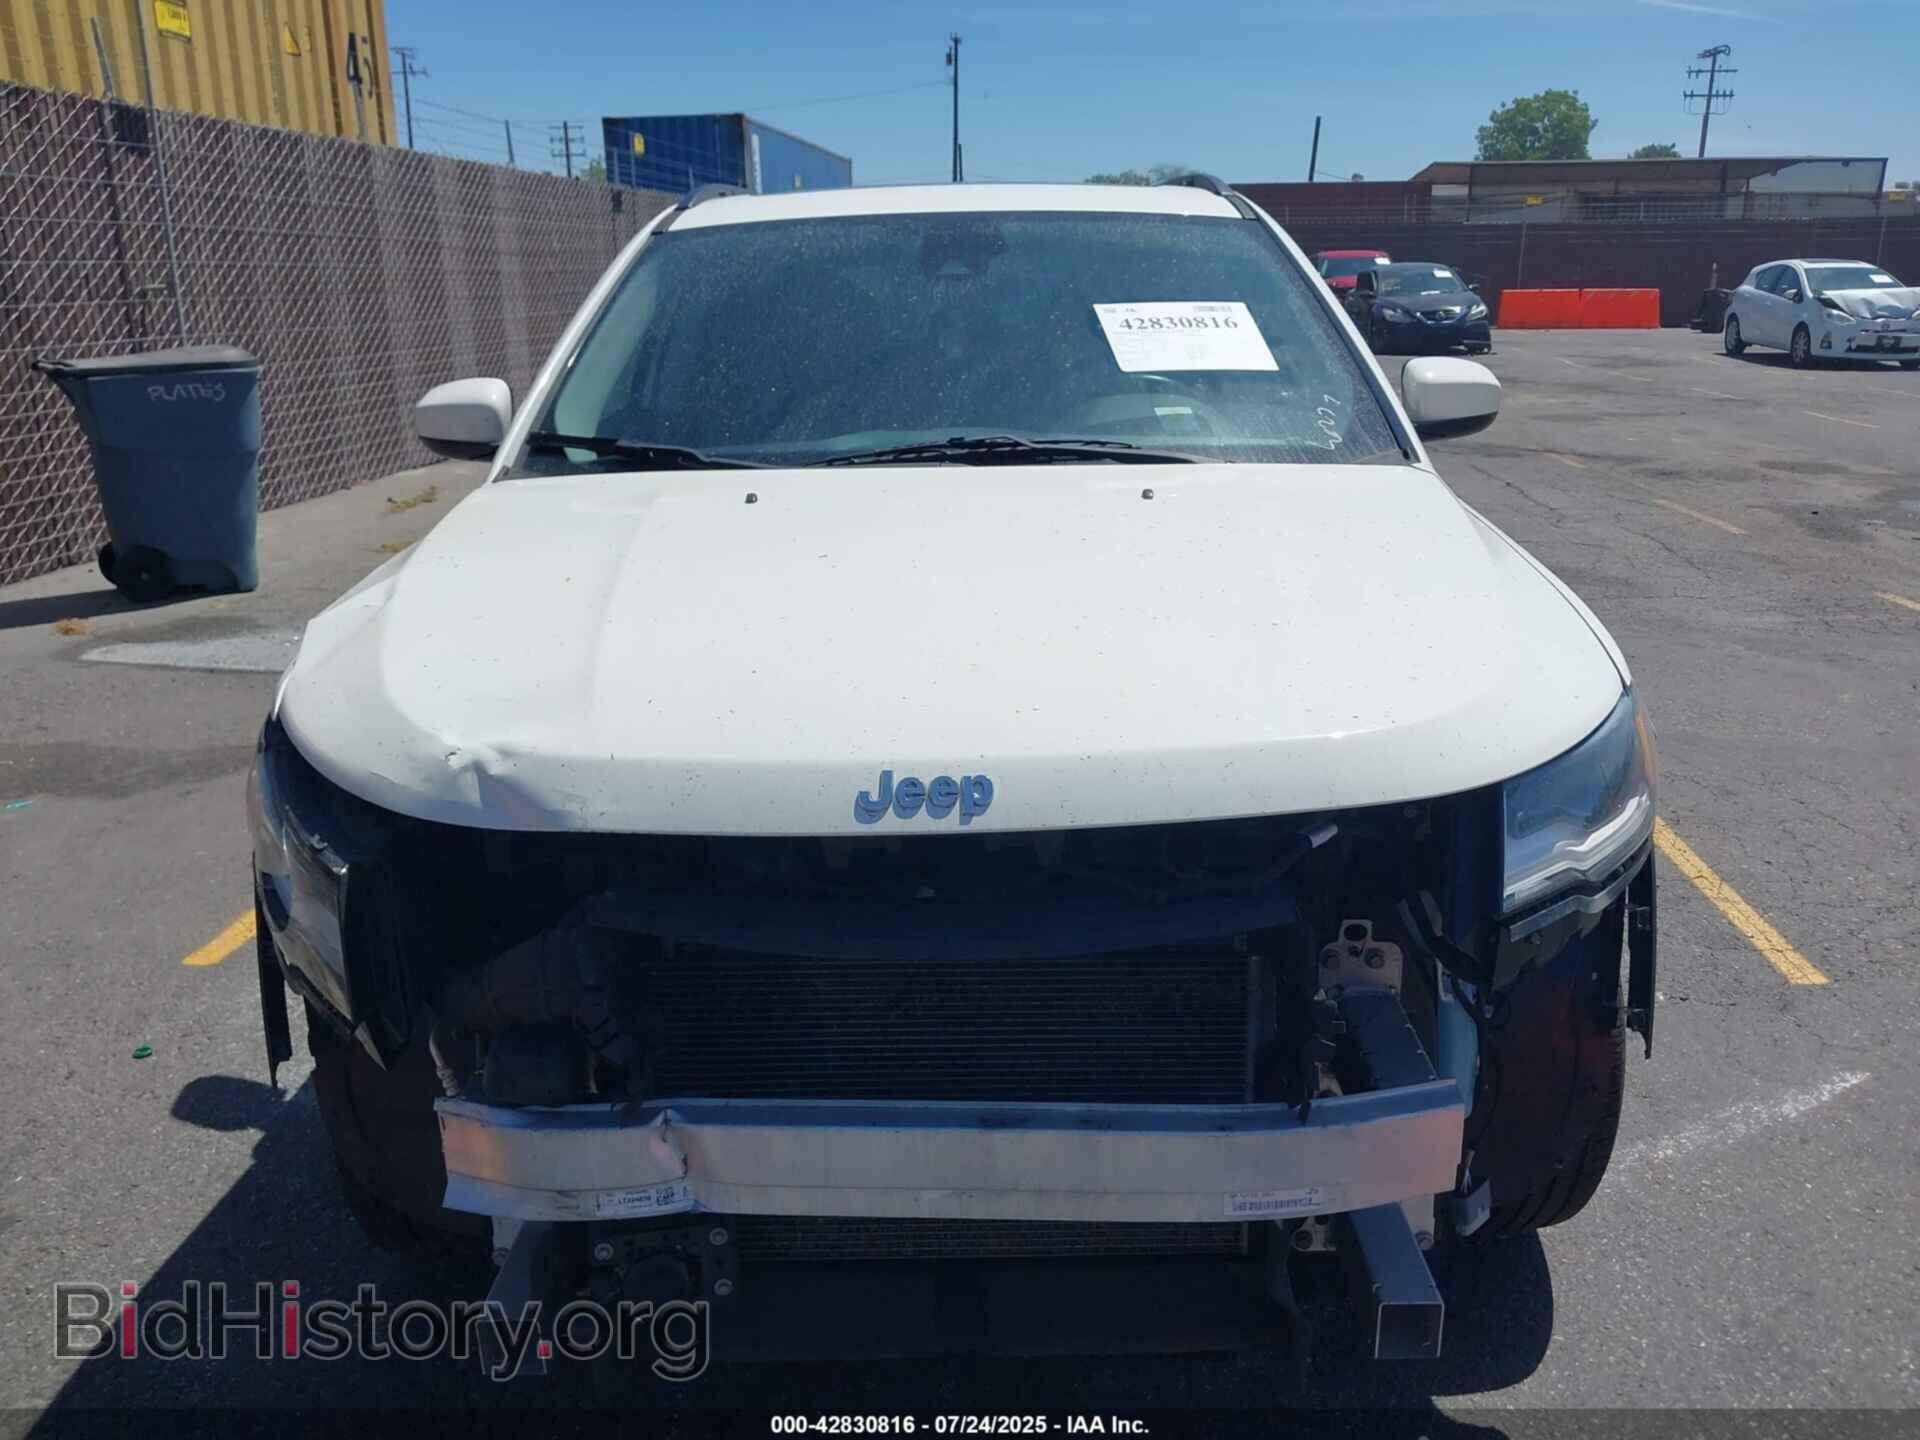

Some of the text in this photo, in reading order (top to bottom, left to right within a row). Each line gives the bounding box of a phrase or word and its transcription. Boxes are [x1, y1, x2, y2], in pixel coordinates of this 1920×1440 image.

[1119, 316, 1238, 331] 42830816
[147, 383, 226, 402] PLATES
[853, 769, 994, 826] Jeep
